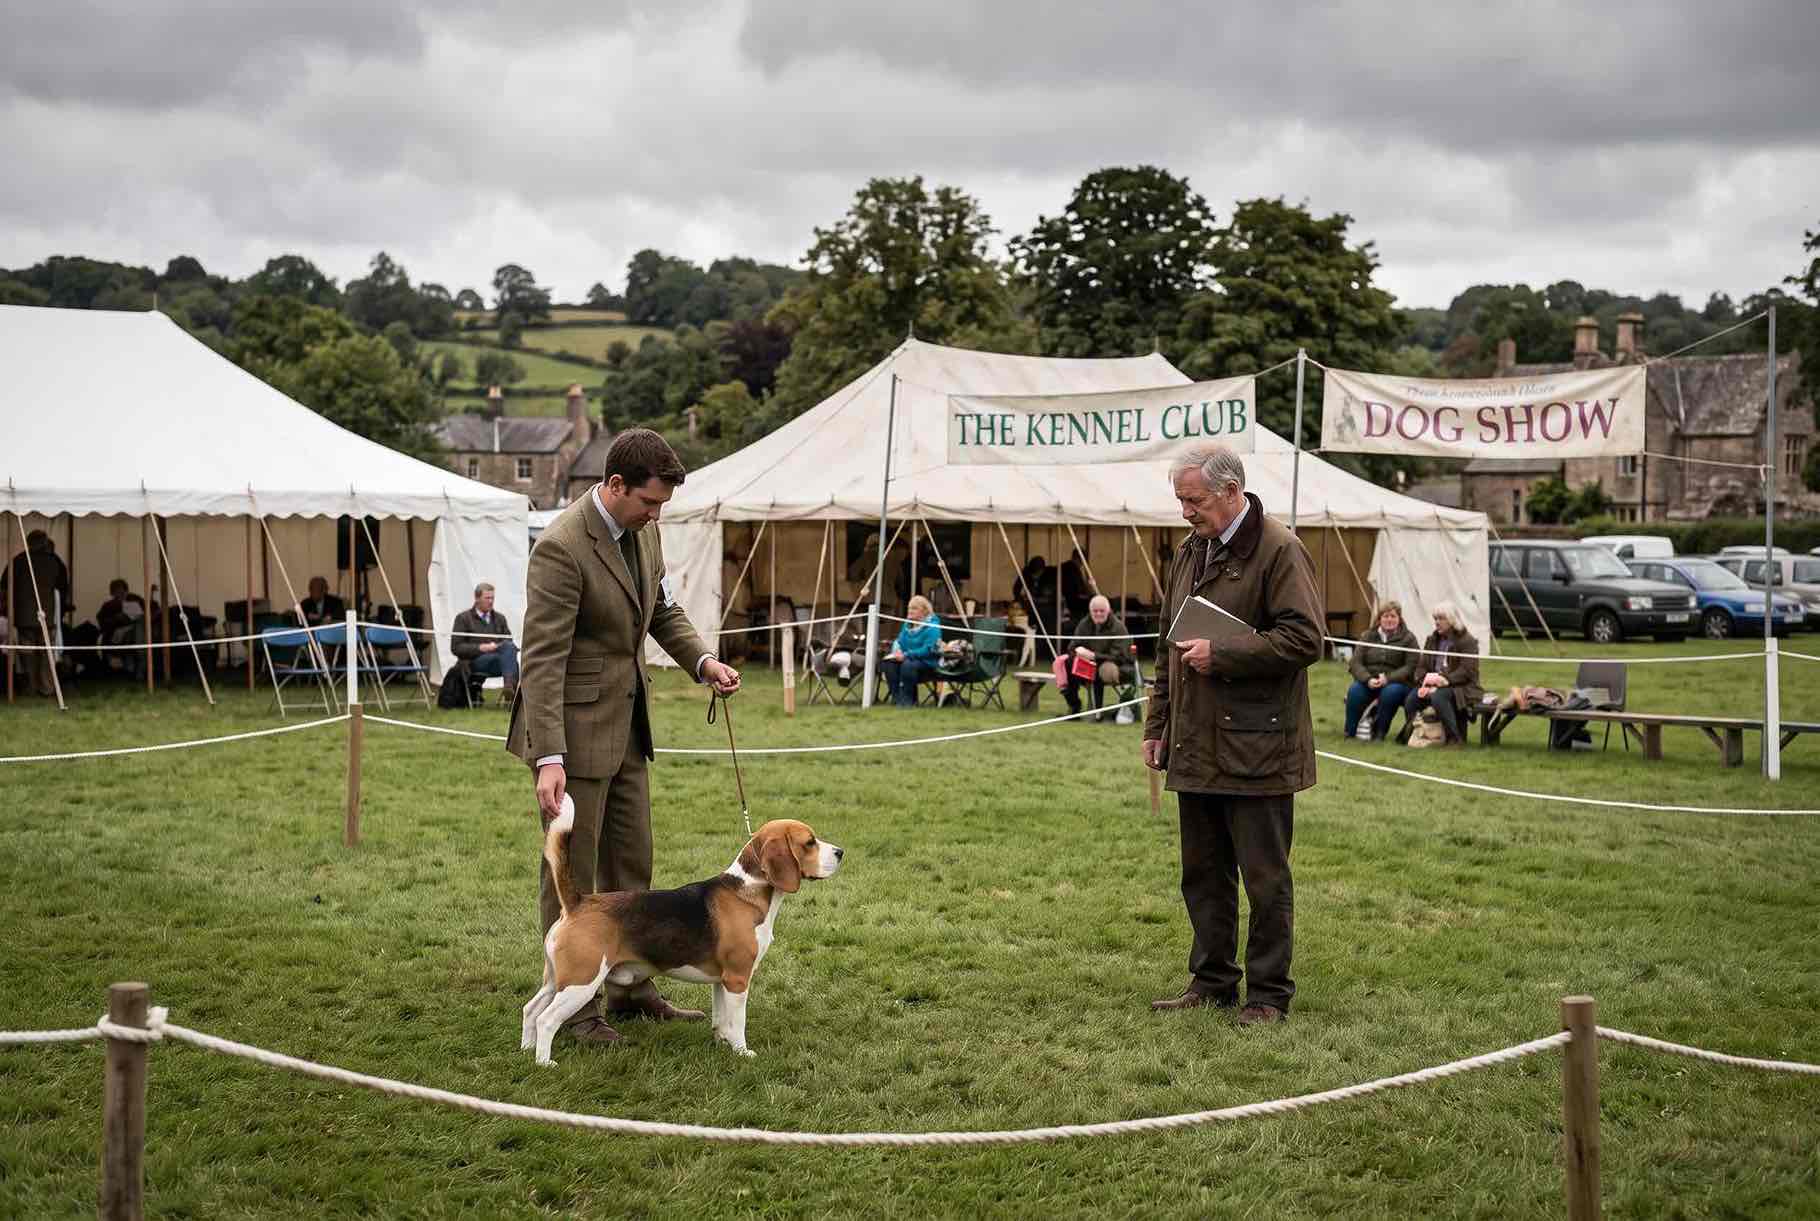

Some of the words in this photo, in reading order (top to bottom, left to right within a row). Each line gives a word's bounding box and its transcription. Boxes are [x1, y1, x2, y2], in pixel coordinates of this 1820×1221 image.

[954, 413, 1016, 446] THE
[1025, 408, 1151, 446] KENNEL
[1161, 399, 1248, 440] CLUB
[1363, 401, 1465, 441] DOG
[1476, 398, 1620, 444] SHOW
